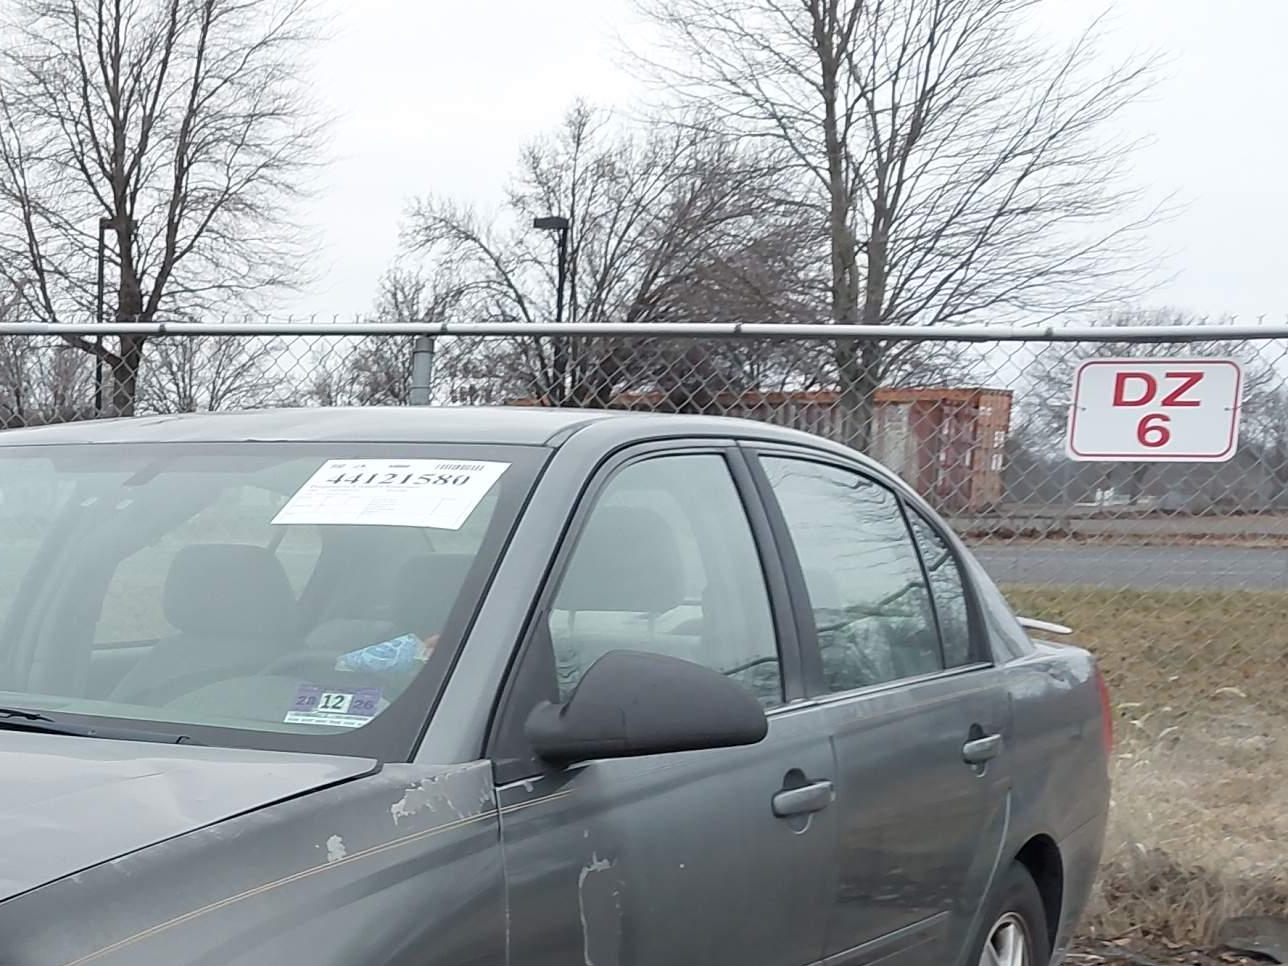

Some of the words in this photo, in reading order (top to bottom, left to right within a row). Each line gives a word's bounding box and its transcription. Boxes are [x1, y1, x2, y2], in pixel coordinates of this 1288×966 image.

[1112, 372, 1205, 407] DZ
[1137, 413, 1171, 448] 6
[326, 472, 471, 486] 44121580
[320, 694, 345, 710] 12
